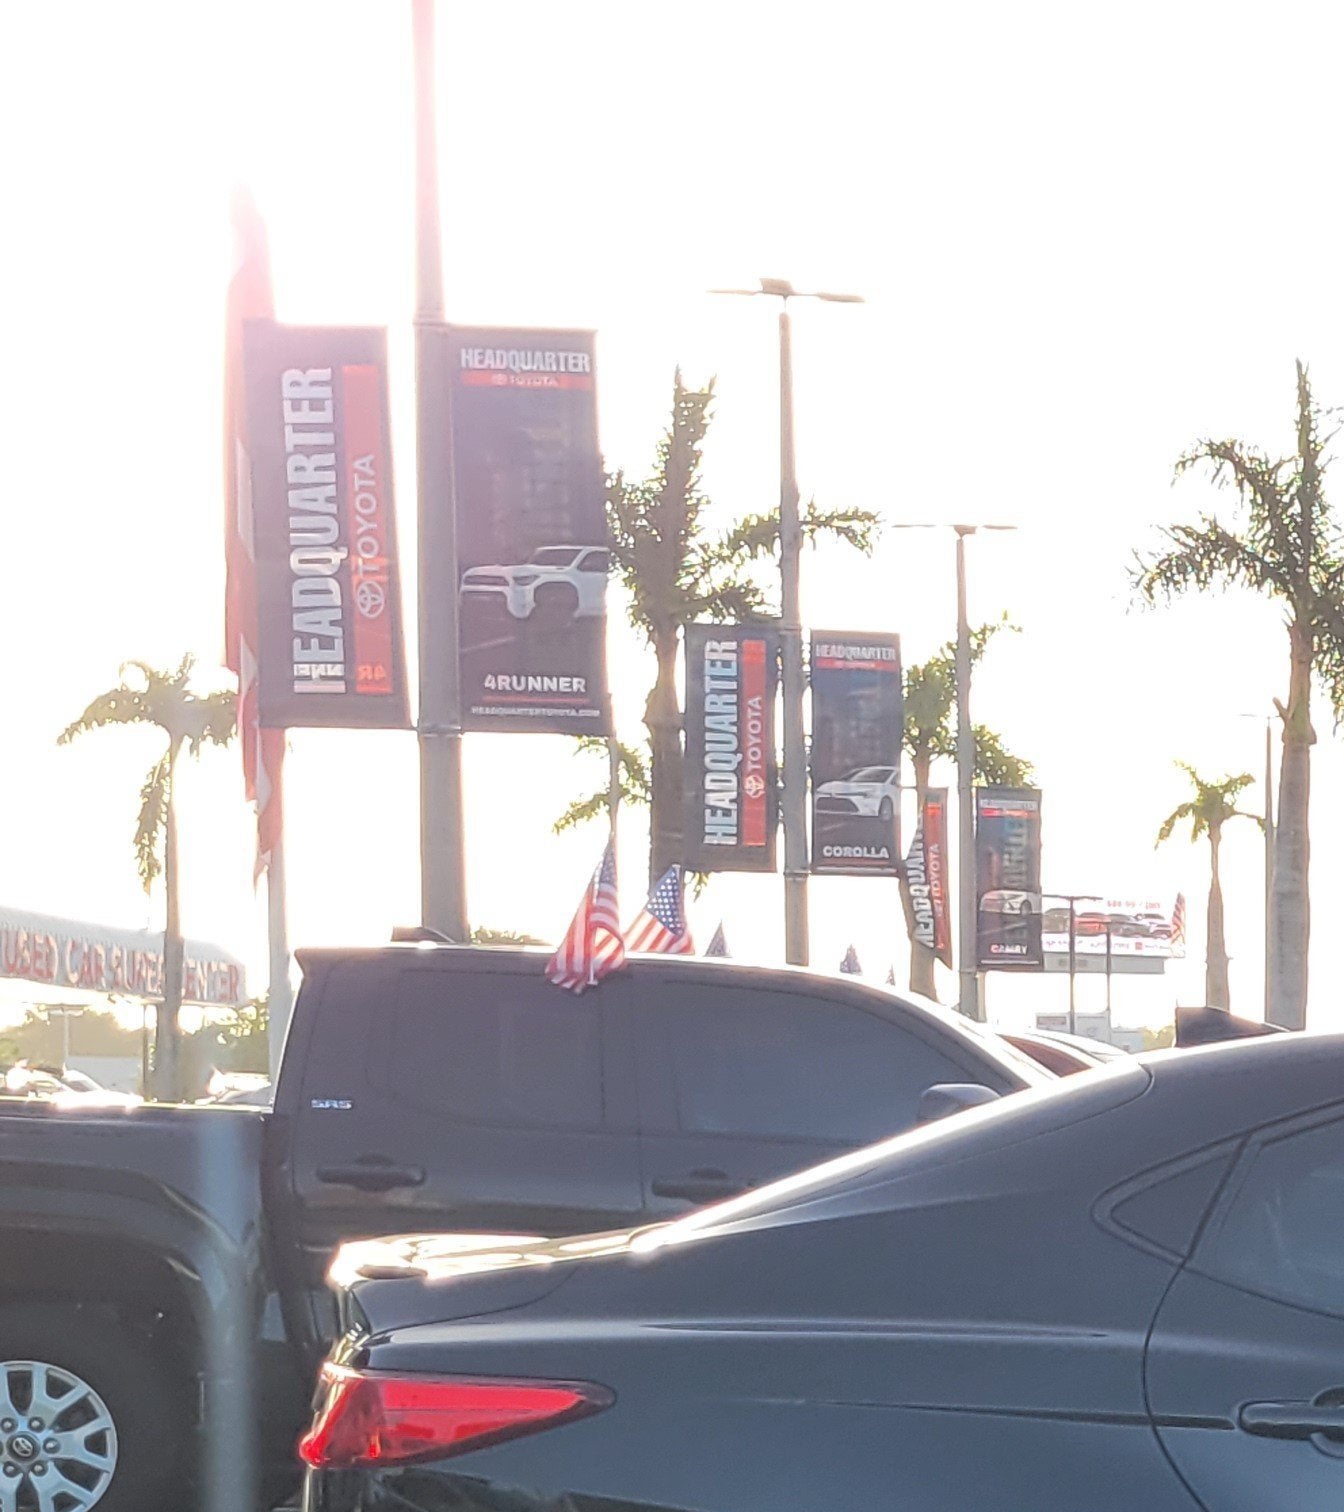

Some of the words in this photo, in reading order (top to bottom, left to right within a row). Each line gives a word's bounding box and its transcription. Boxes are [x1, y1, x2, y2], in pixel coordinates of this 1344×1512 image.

[460, 348, 591, 373] HEADQUARTER
[281, 367, 347, 694] HEADQUARTER
[354, 454, 380, 578] TOYOTA
[484, 674, 586, 692] 4RUNNER
[703, 640, 742, 846] HEADQUARTER
[747, 695, 763, 774] TOYOTA
[823, 845, 889, 859] COROLLA
[65, 935, 107, 989] CAR
[182, 957, 240, 1003] ENTER
